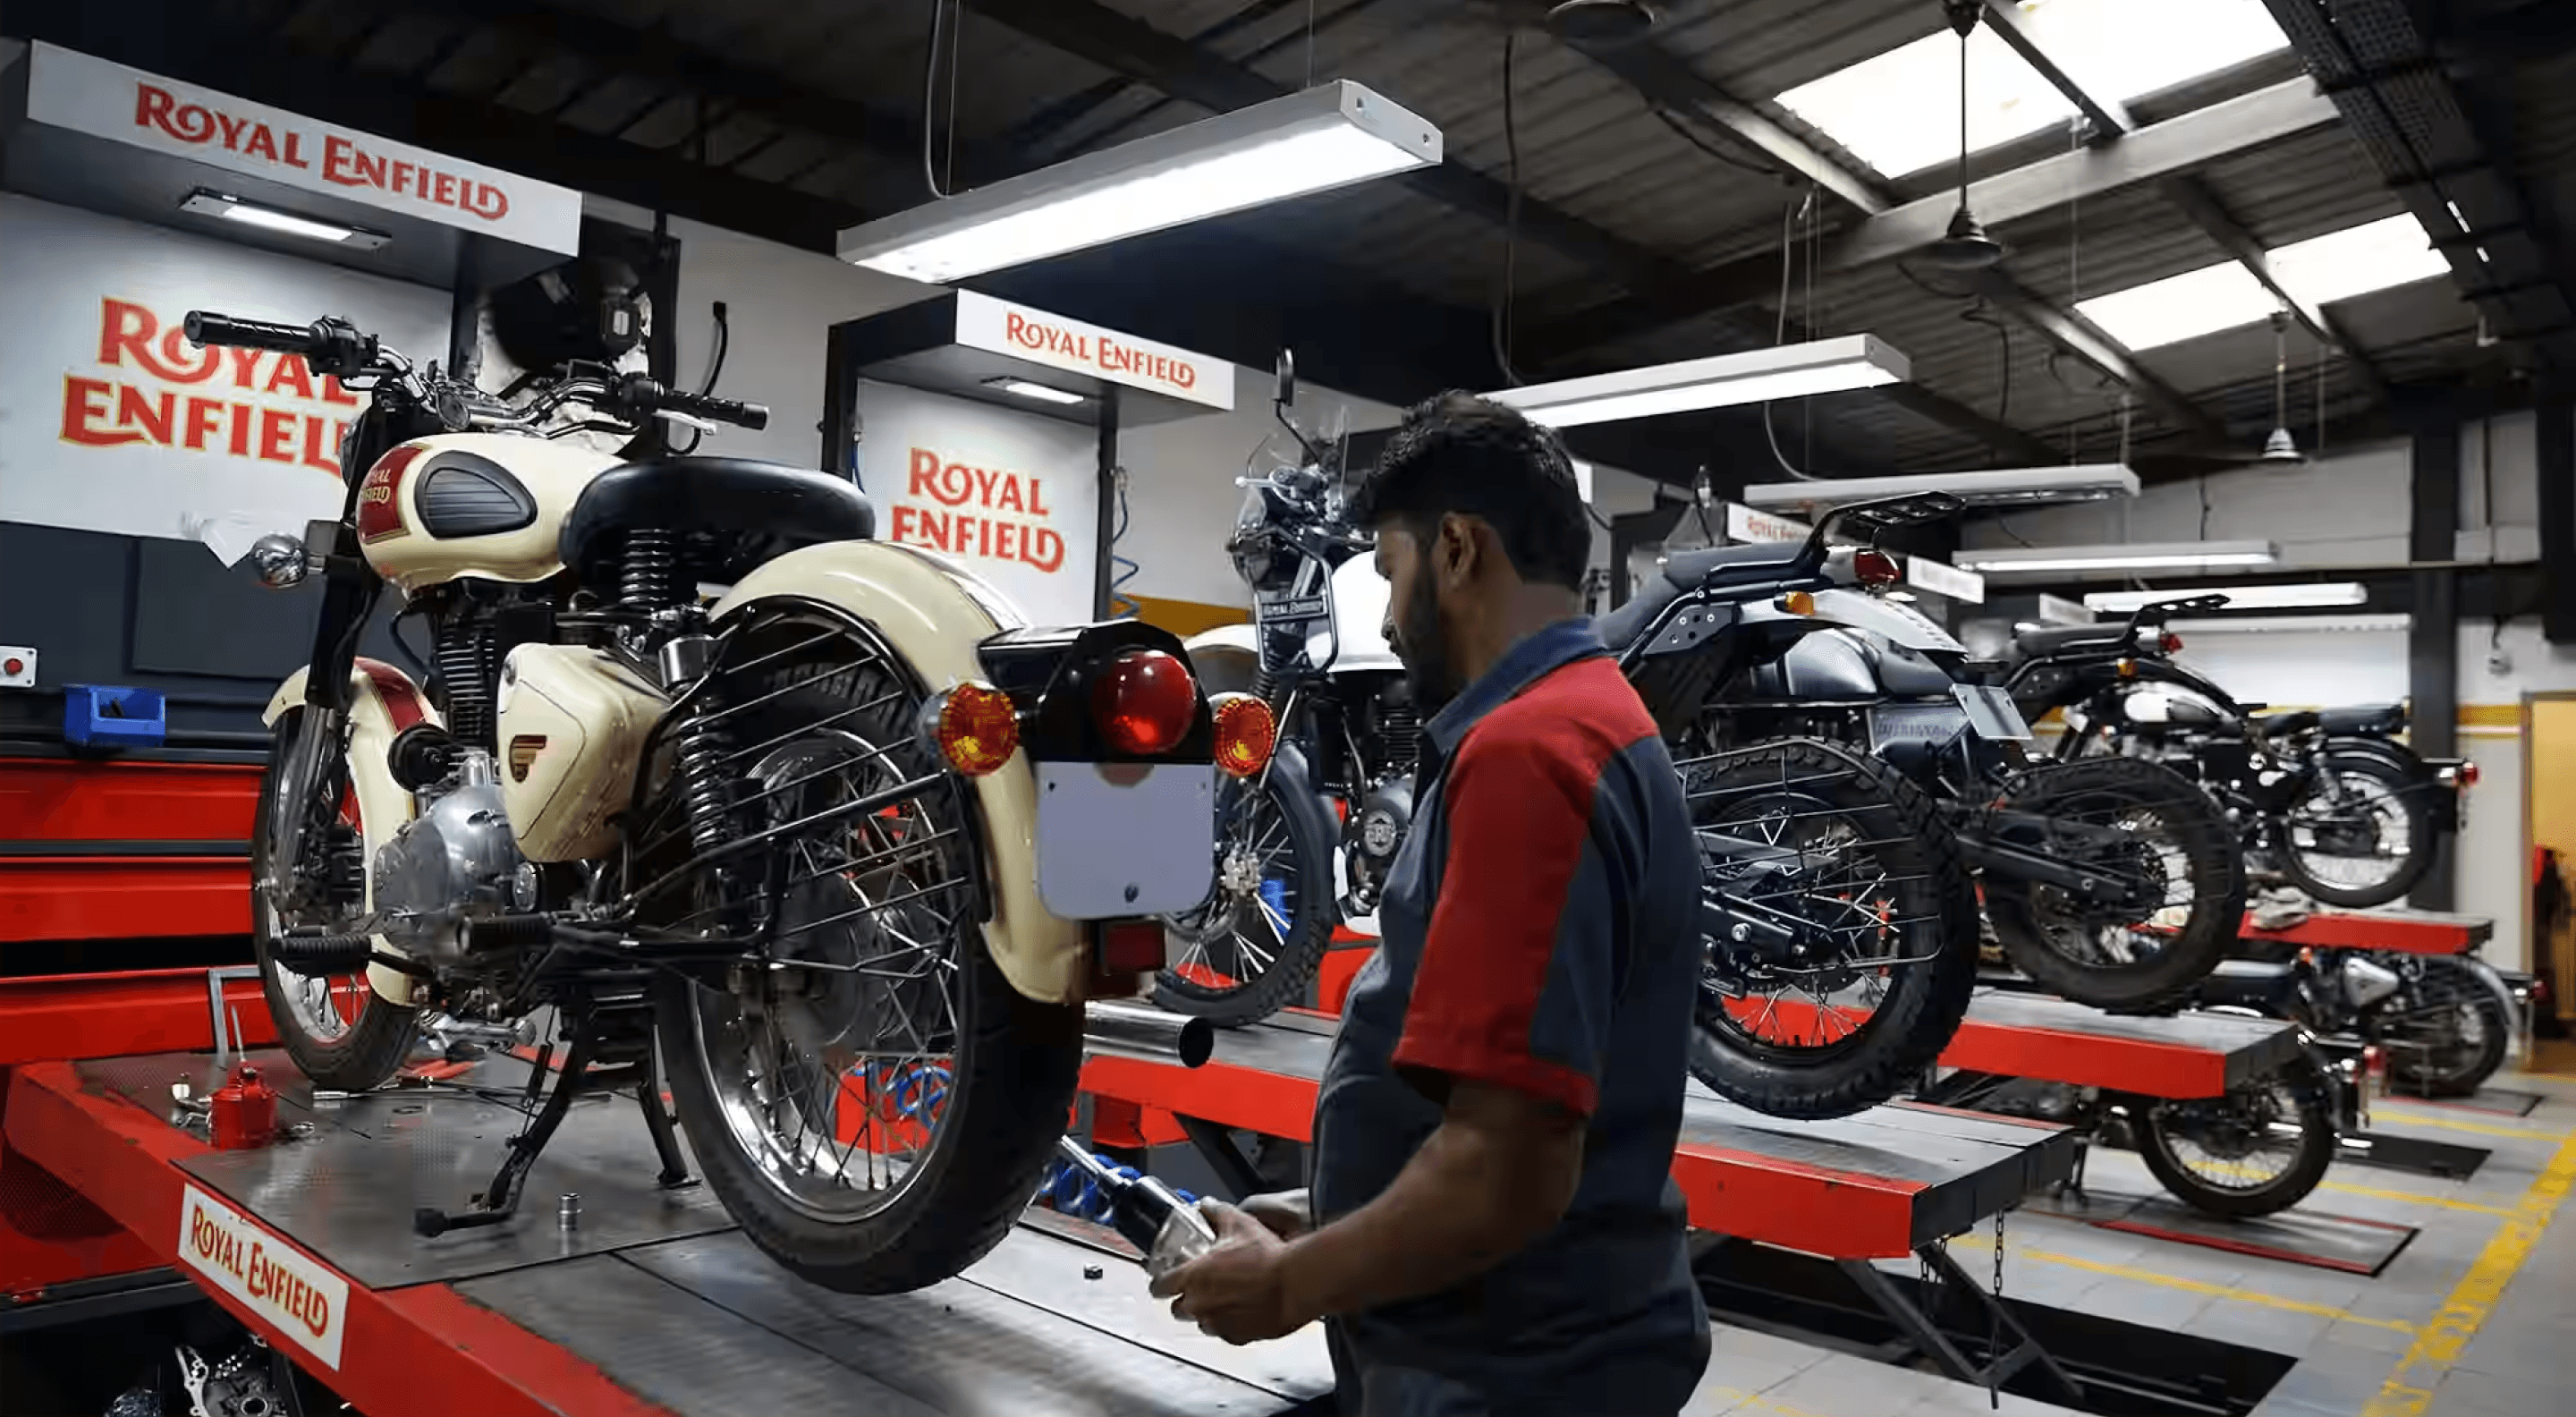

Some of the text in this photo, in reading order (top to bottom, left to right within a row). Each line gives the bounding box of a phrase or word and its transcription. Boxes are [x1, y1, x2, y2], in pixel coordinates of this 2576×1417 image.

[135, 82, 508, 220] ROYAL ENFIELD
[1006, 312, 1195, 388] ROYAL ENFIELD
[60, 374, 344, 479] ENFIEL
[909, 447, 1048, 517] ROYAL
[892, 505, 1065, 574] ENFIELD
[191, 1203, 328, 1338] ROYAL ENFIELD
